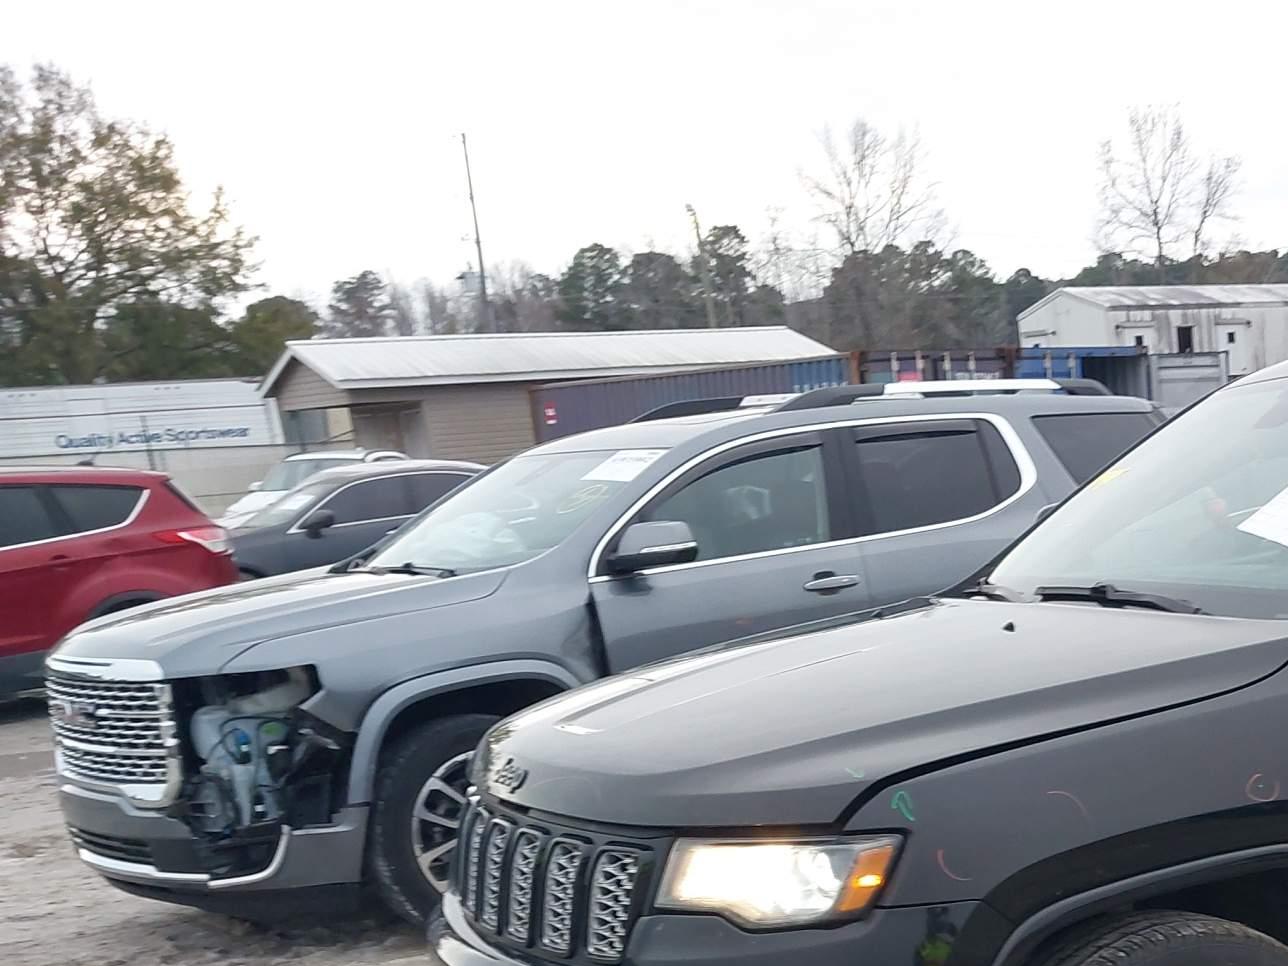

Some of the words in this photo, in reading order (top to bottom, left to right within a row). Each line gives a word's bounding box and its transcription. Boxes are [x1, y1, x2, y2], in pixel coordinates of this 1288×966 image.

[55, 433, 113, 449] Quality
[117, 431, 161, 445] Active
[164, 427, 249, 443] Sportswear
